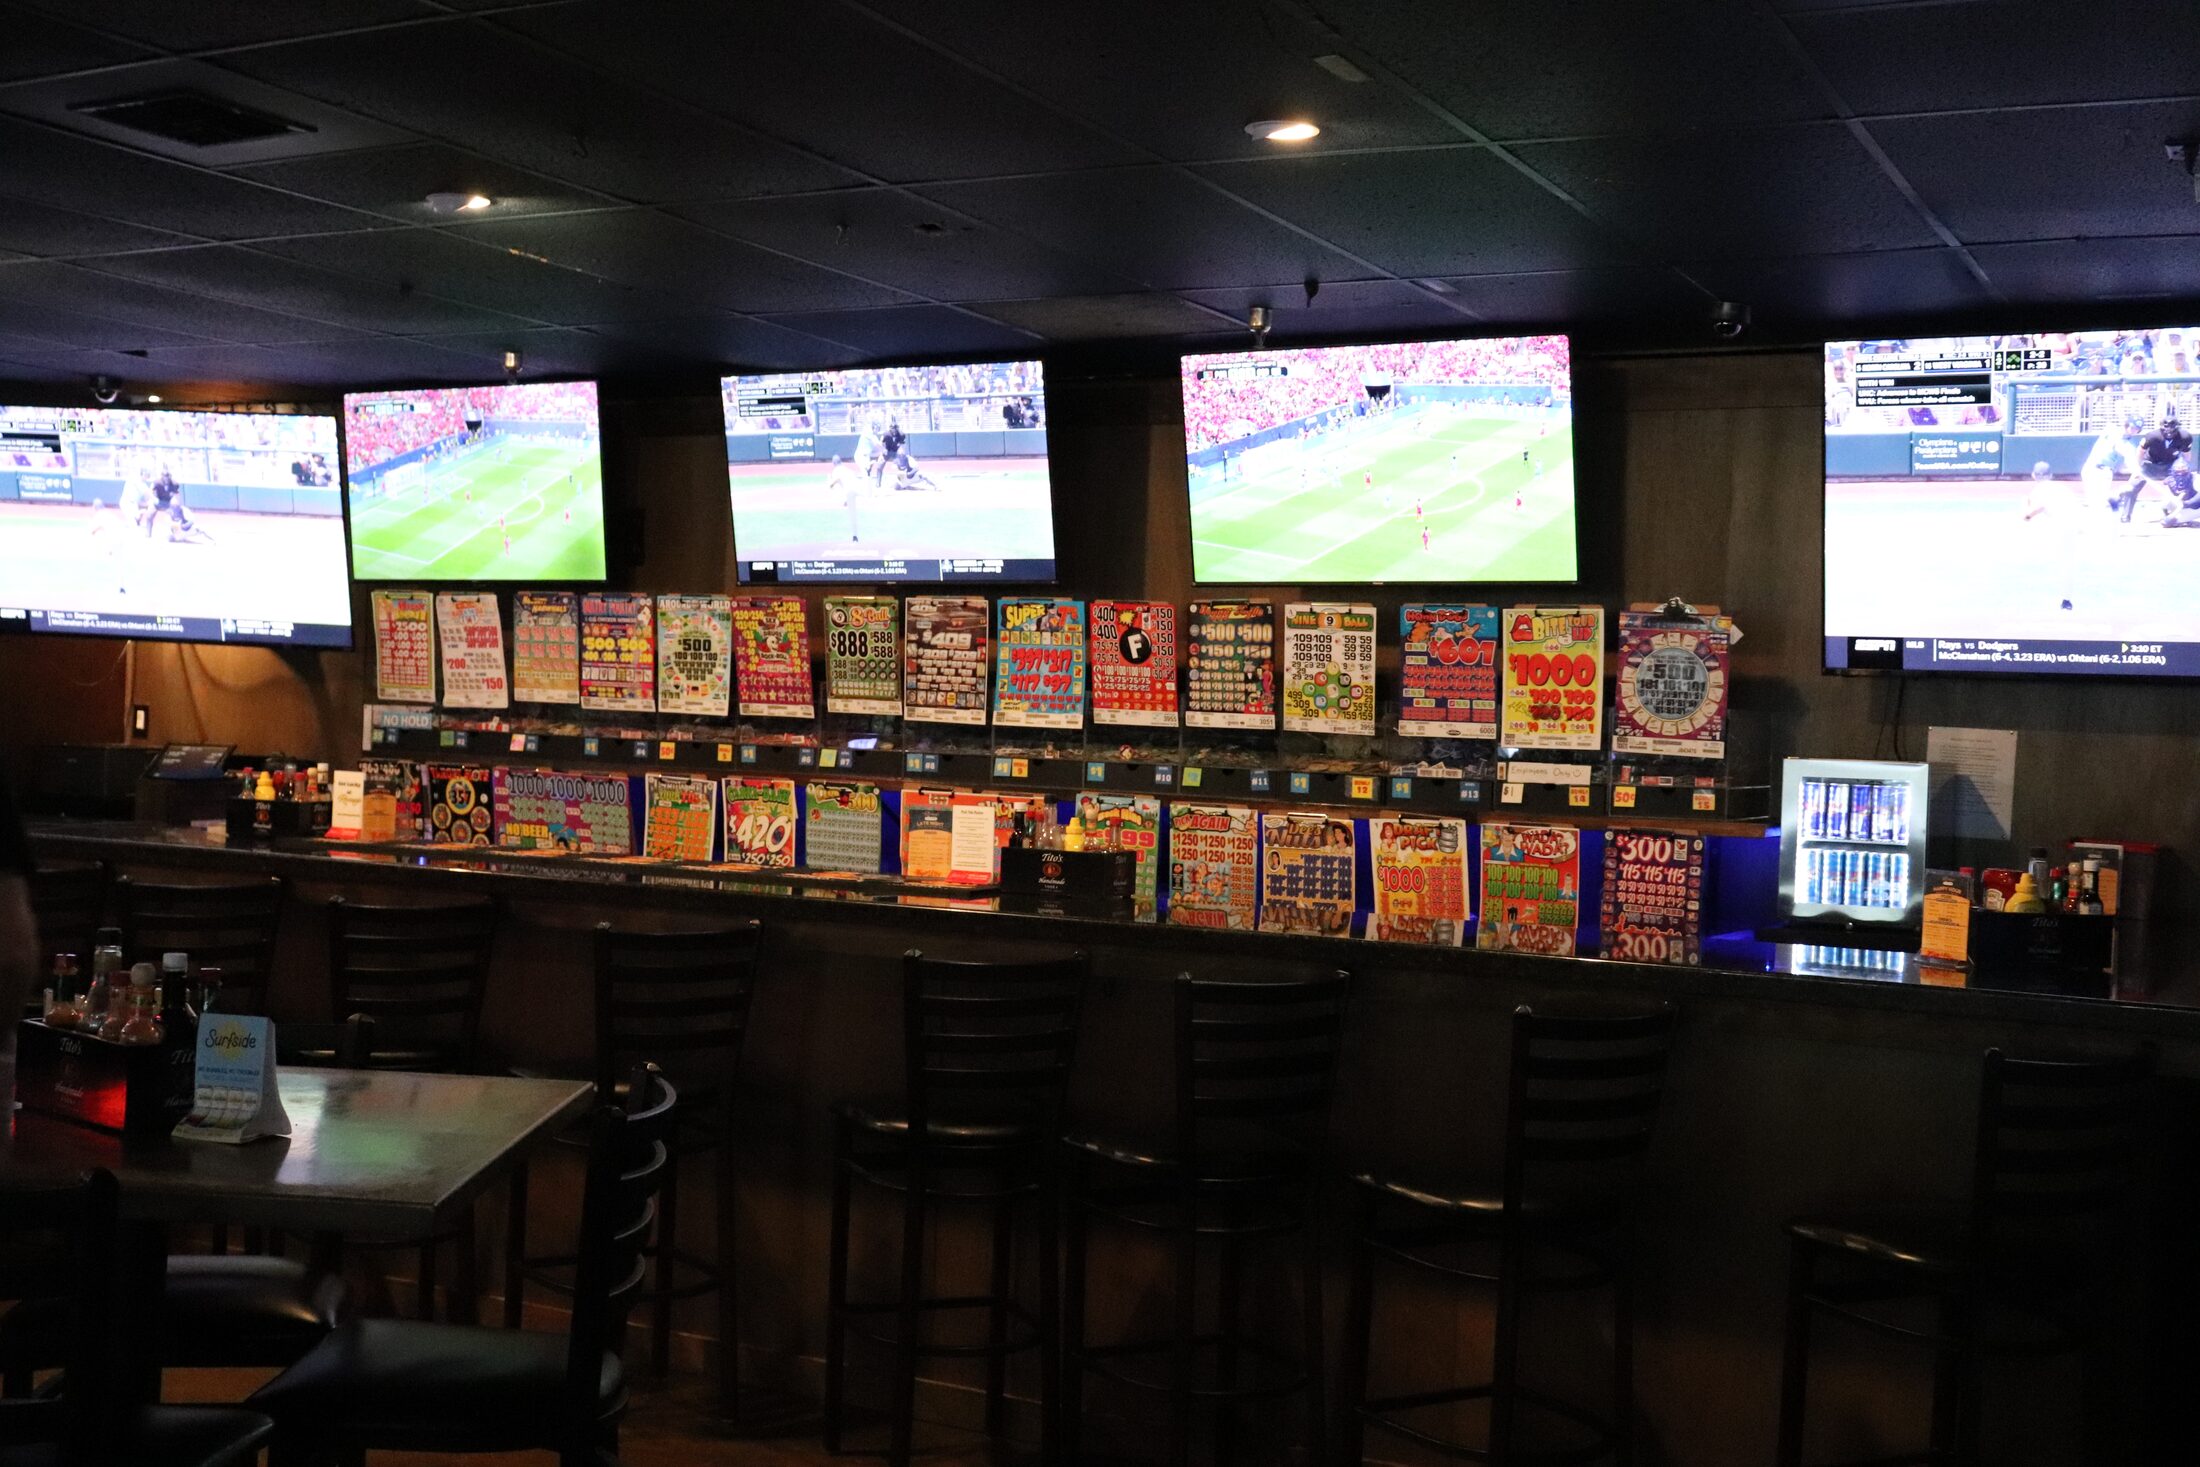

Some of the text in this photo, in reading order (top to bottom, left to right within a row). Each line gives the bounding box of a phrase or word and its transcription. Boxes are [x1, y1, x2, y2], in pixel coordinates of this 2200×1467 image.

[1006, 604, 1046, 630] SUPER
[1093, 607, 1116, 623] $400
[1152, 607, 1173, 619] $150
[1152, 620, 1173, 632] $150
[1292, 615, 1368, 627] NINE 9 BALL
[1567, 614, 1595, 627] YOUR
[1092, 624, 1118, 640] $400
[1201, 623, 1273, 642] $500 $500
[1533, 617, 1567, 641] BITE
[831, 630, 868, 657] $888
[871, 632, 893, 643] $588
[1152, 632, 1173, 644] $150
[678, 638, 712, 652] $500
[871, 646, 893, 658] $588
[1128, 633, 1143, 660] F
[1152, 645, 1174, 656] $150
[1201, 644, 1234, 658] $150
[1428, 637, 1496, 666] $601
[1938, 640, 1961, 650] Rays
[1978, 641, 2018, 651] Dodgers
[446, 658, 465, 669] $200
[1043, 648, 1073, 673] $217
[1200, 660, 1219, 670] $50
[1938, 651, 1990, 660] McClanahan
[2034, 654, 2056, 663] ERA)
[2068, 654, 2098, 662] Ohtani
[2142, 656, 2166, 665] ERA)
[1508, 653, 1596, 687] $1000
[1647, 664, 1696, 680] $500
[482, 677, 503, 689] $150
[1010, 673, 1073, 694] $117 $97
[1529, 689, 1596, 705] $100 $100
[383, 715, 429, 727] NO HOLD
[1155, 774, 1172, 782] #10
[1511, 767, 1573, 778] Employees Only
[1252, 777, 1268, 786] #11
[1293, 777, 1307, 789] $1
[1395, 783, 1409, 793] $1
[505, 774, 545, 797] $1000
[545, 776, 585, 800] $1000
[586, 779, 627, 805] $1000
[1357, 786, 1368, 794] 12
[1460, 790, 1479, 799] #13
[848, 792, 878, 813] 500
[1574, 795, 1586, 803] 14
[1615, 791, 1635, 803] 50¢
[1698, 801, 1710, 809] 15
[507, 822, 548, 838] NO BEER
[1191, 815, 1230, 831] AGAIN
[1287, 822, 1321, 837] Dee's
[1393, 822, 1442, 837] DRAFT
[729, 814, 792, 853] $420
[1265, 830, 1322, 848] Nuts
[1173, 832, 1253, 850] $1250 $1250 $1250
[1400, 836, 1440, 851] PICK
[1520, 839, 1569, 856] WADA?
[1172, 847, 1253, 865] $1250 $1250 $1250
[1616, 835, 1671, 863] $300
[742, 854, 791, 866] $250 $250
[1041, 853, 1064, 862] Tito's
[1377, 865, 1425, 893] $1000
[1619, 862, 1687, 884] $115 $115 $115
[1038, 877, 1066, 885] Handmade
[2032, 917, 2059, 928] Tito's
[60, 1037, 82, 1054] Tito's
[205, 1028, 257, 1049] Surfside
